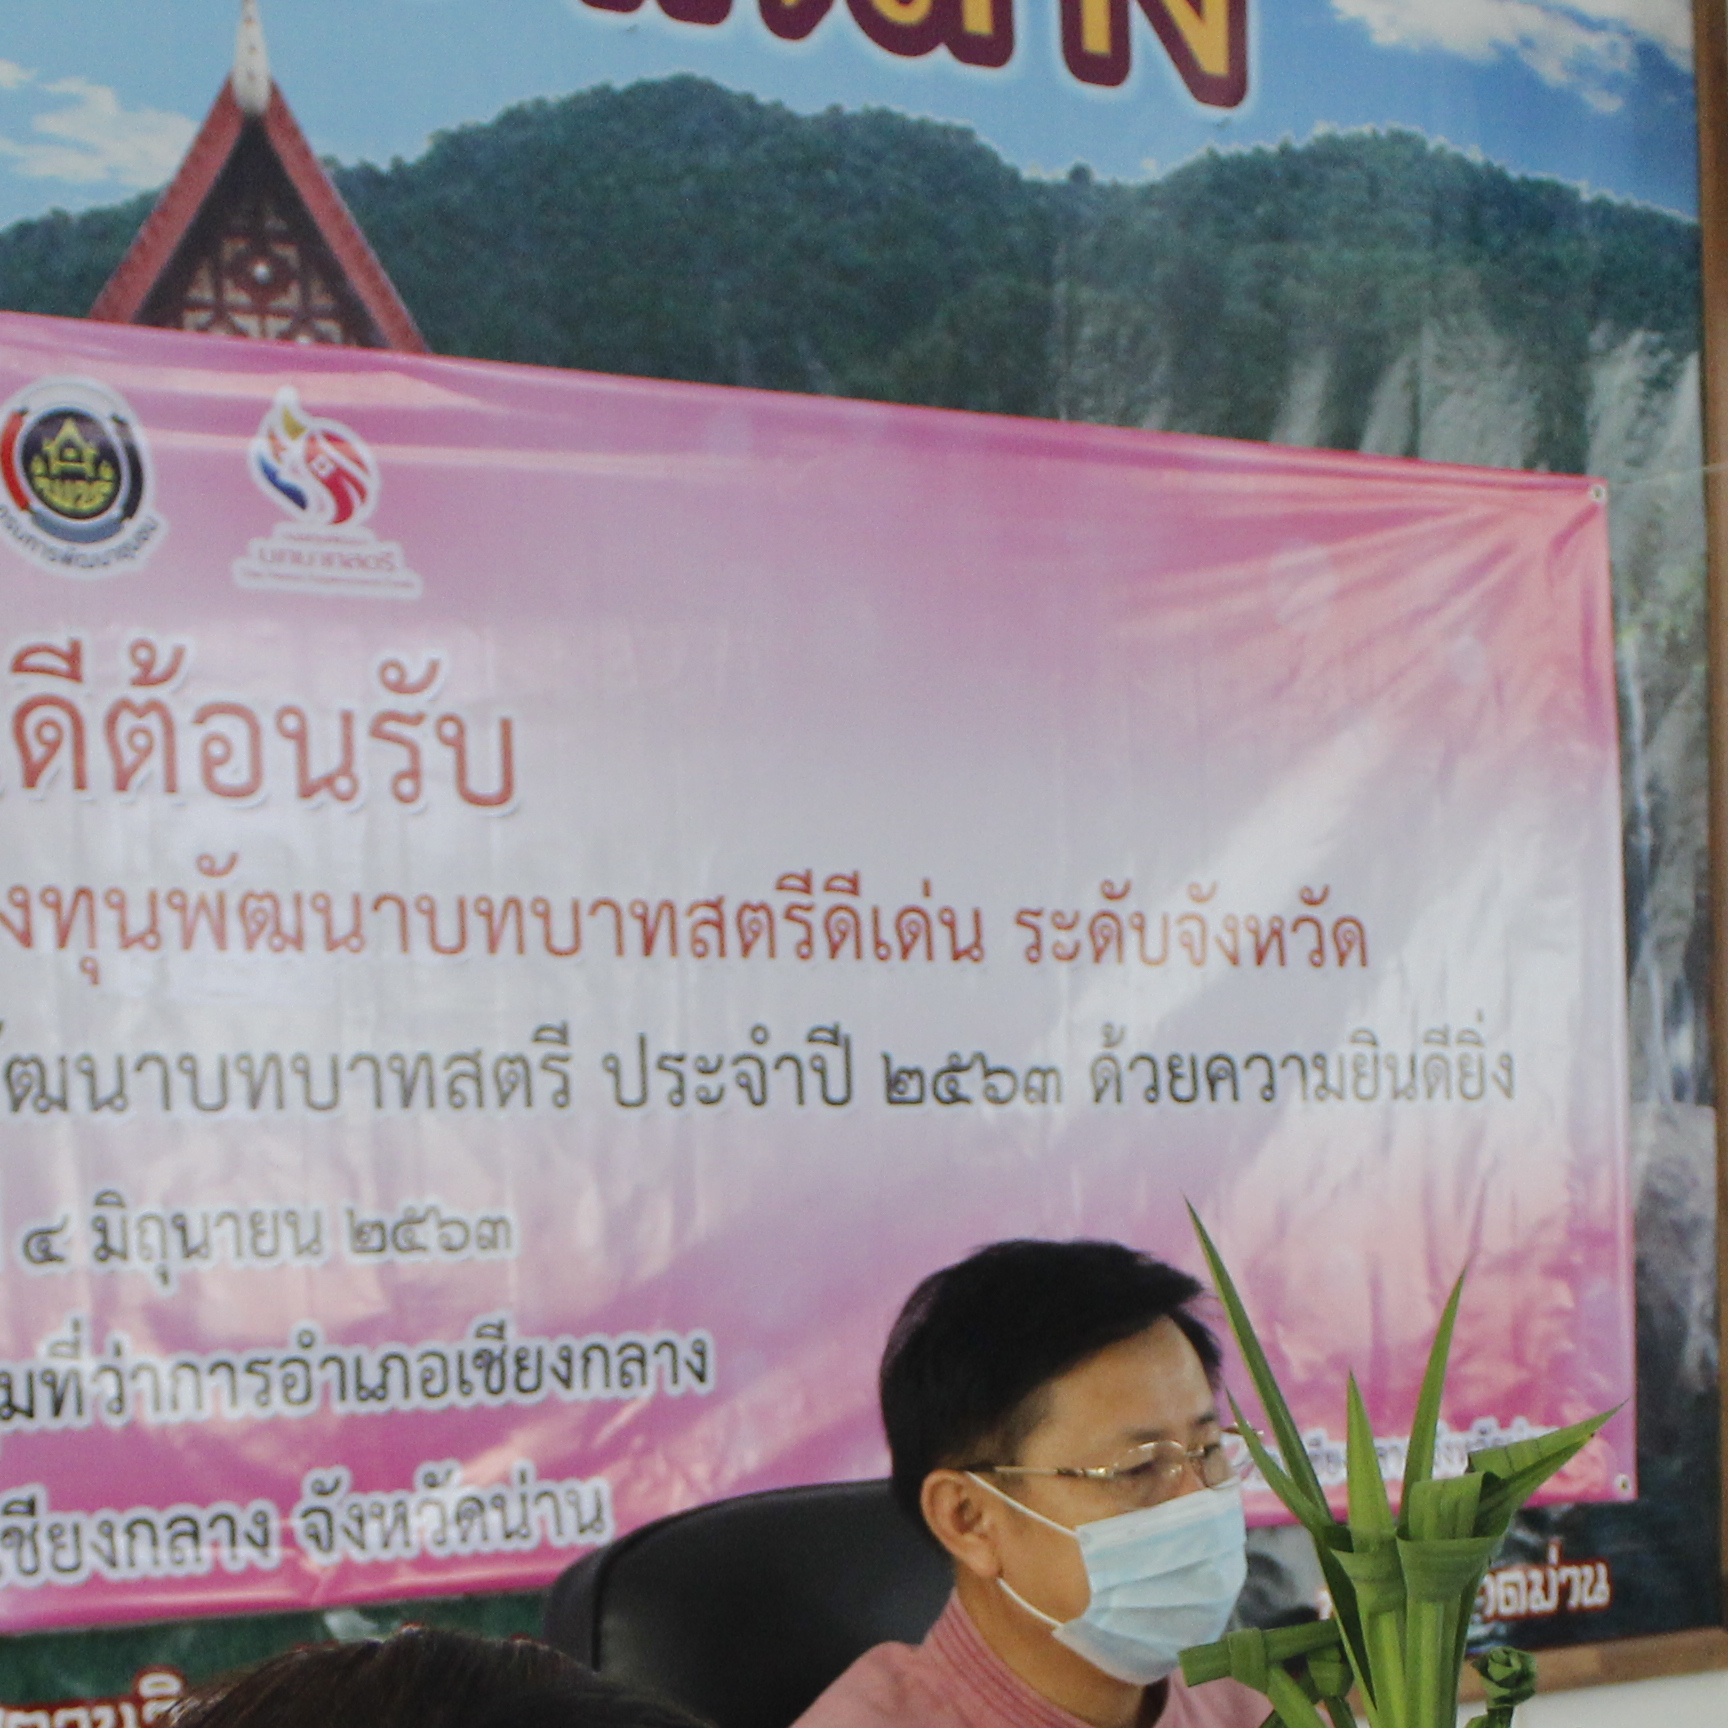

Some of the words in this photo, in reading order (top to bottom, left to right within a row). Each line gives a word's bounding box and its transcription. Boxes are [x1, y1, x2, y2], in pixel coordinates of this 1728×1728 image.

[1015, 875, 1370, 973] ระดับจังหวัด
[603, 1029, 852, 1108] ประจำปี
[883, 1050, 1065, 1111] ๒๕๖๓
[1091, 1010, 1516, 1108] ด้วยความยินดียิ่ง
[91, 1199, 323, 1283] มิถุนายน
[345, 1207, 513, 1265] ๒๕๖๓
[298, 1469, 606, 1555] จังหวัดน่าน
